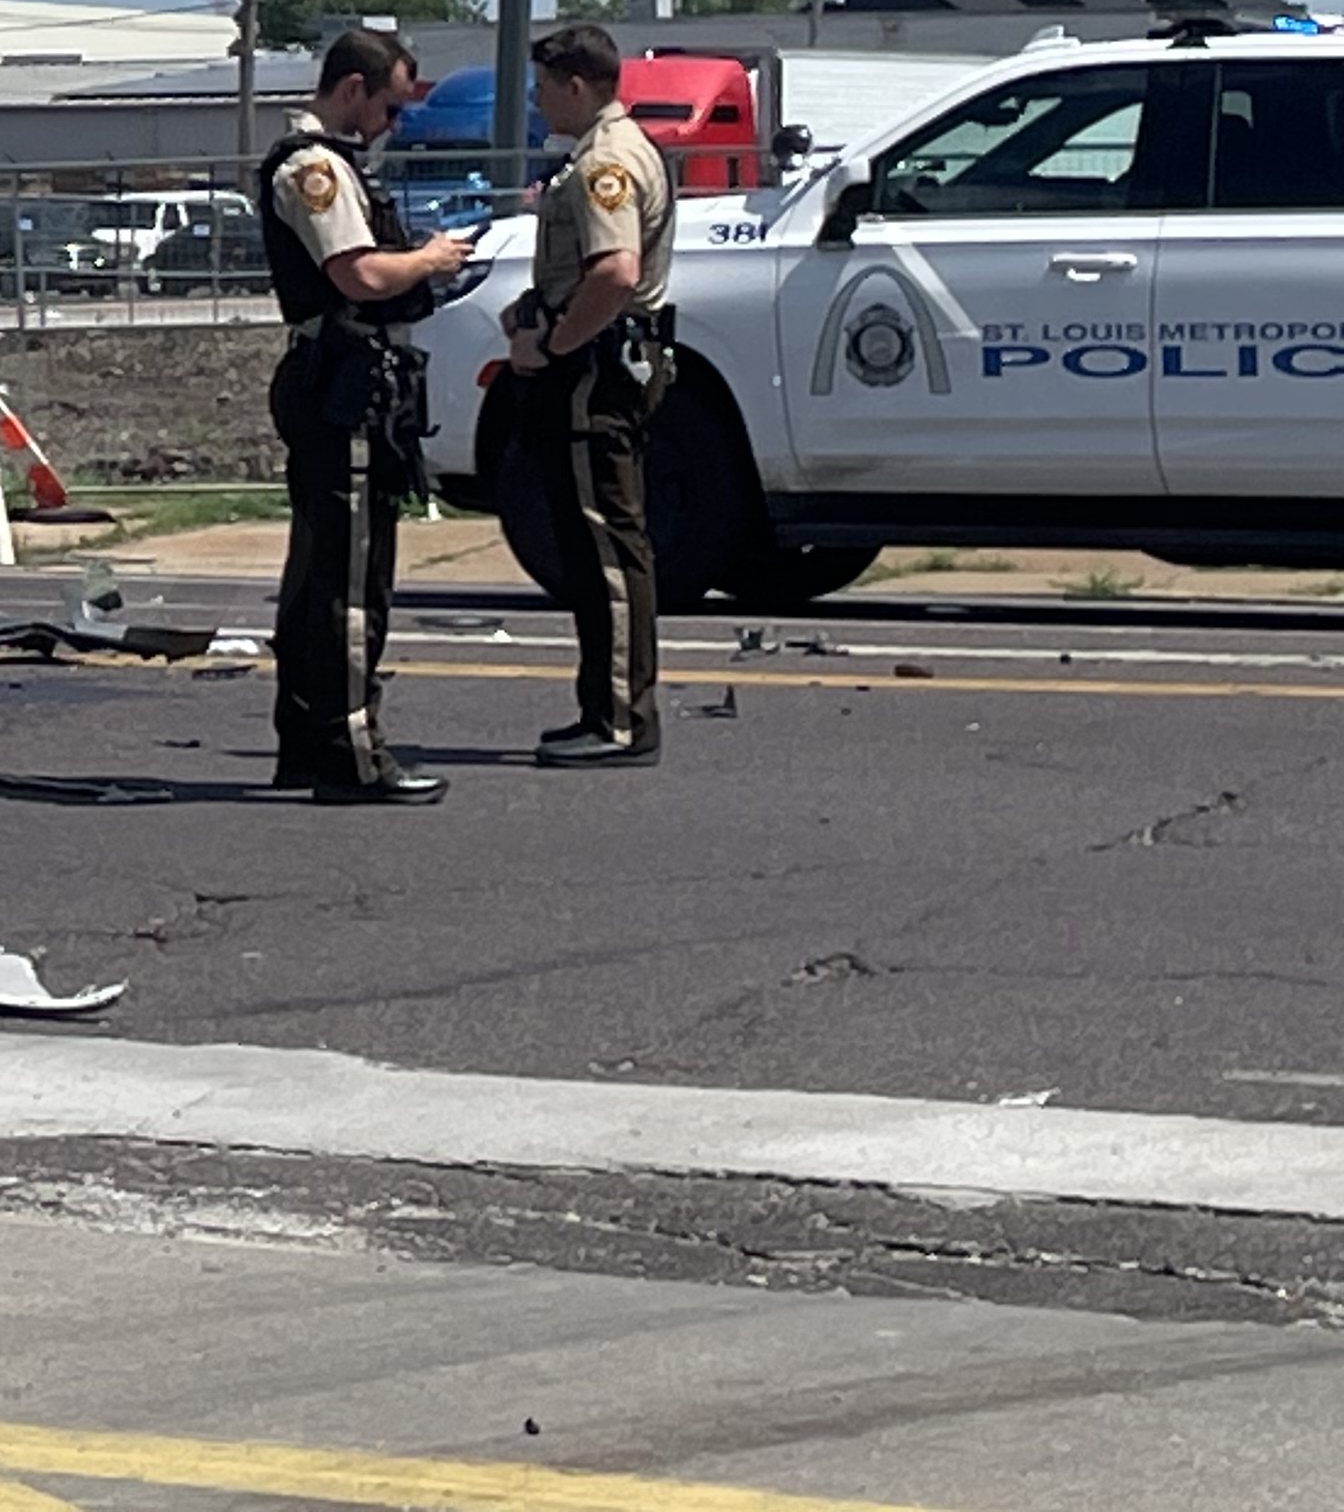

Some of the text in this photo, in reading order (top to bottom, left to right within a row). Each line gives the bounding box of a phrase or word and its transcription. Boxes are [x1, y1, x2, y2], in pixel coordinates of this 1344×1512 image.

[982, 323, 1029, 342] ST.
[1042, 323, 1147, 342] LOUIS
[982, 343, 1344, 378] POLIC
